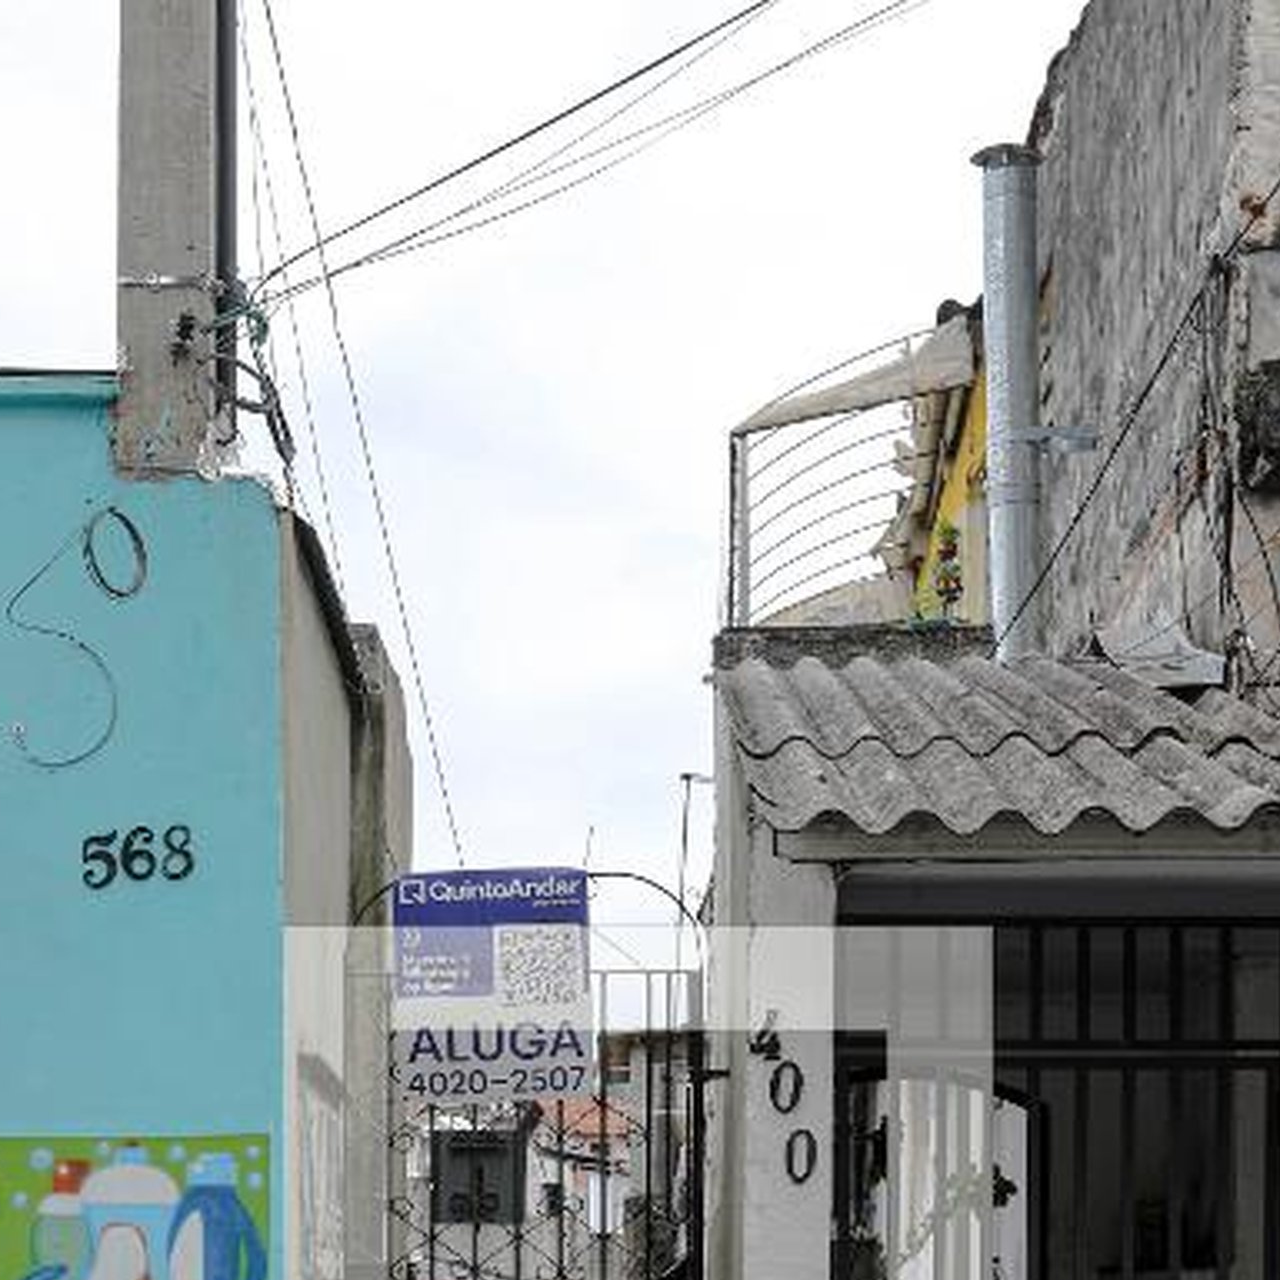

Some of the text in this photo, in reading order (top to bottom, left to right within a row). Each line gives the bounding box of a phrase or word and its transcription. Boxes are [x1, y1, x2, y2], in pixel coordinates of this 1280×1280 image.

[82, 825, 194, 890] 568
[429, 876, 581, 903] QuintoAndar
[408, 1022, 585, 1063] ALUGA
[407, 1066, 585, 1096] 4020-2507
[749, 1011, 817, 1185] 400
